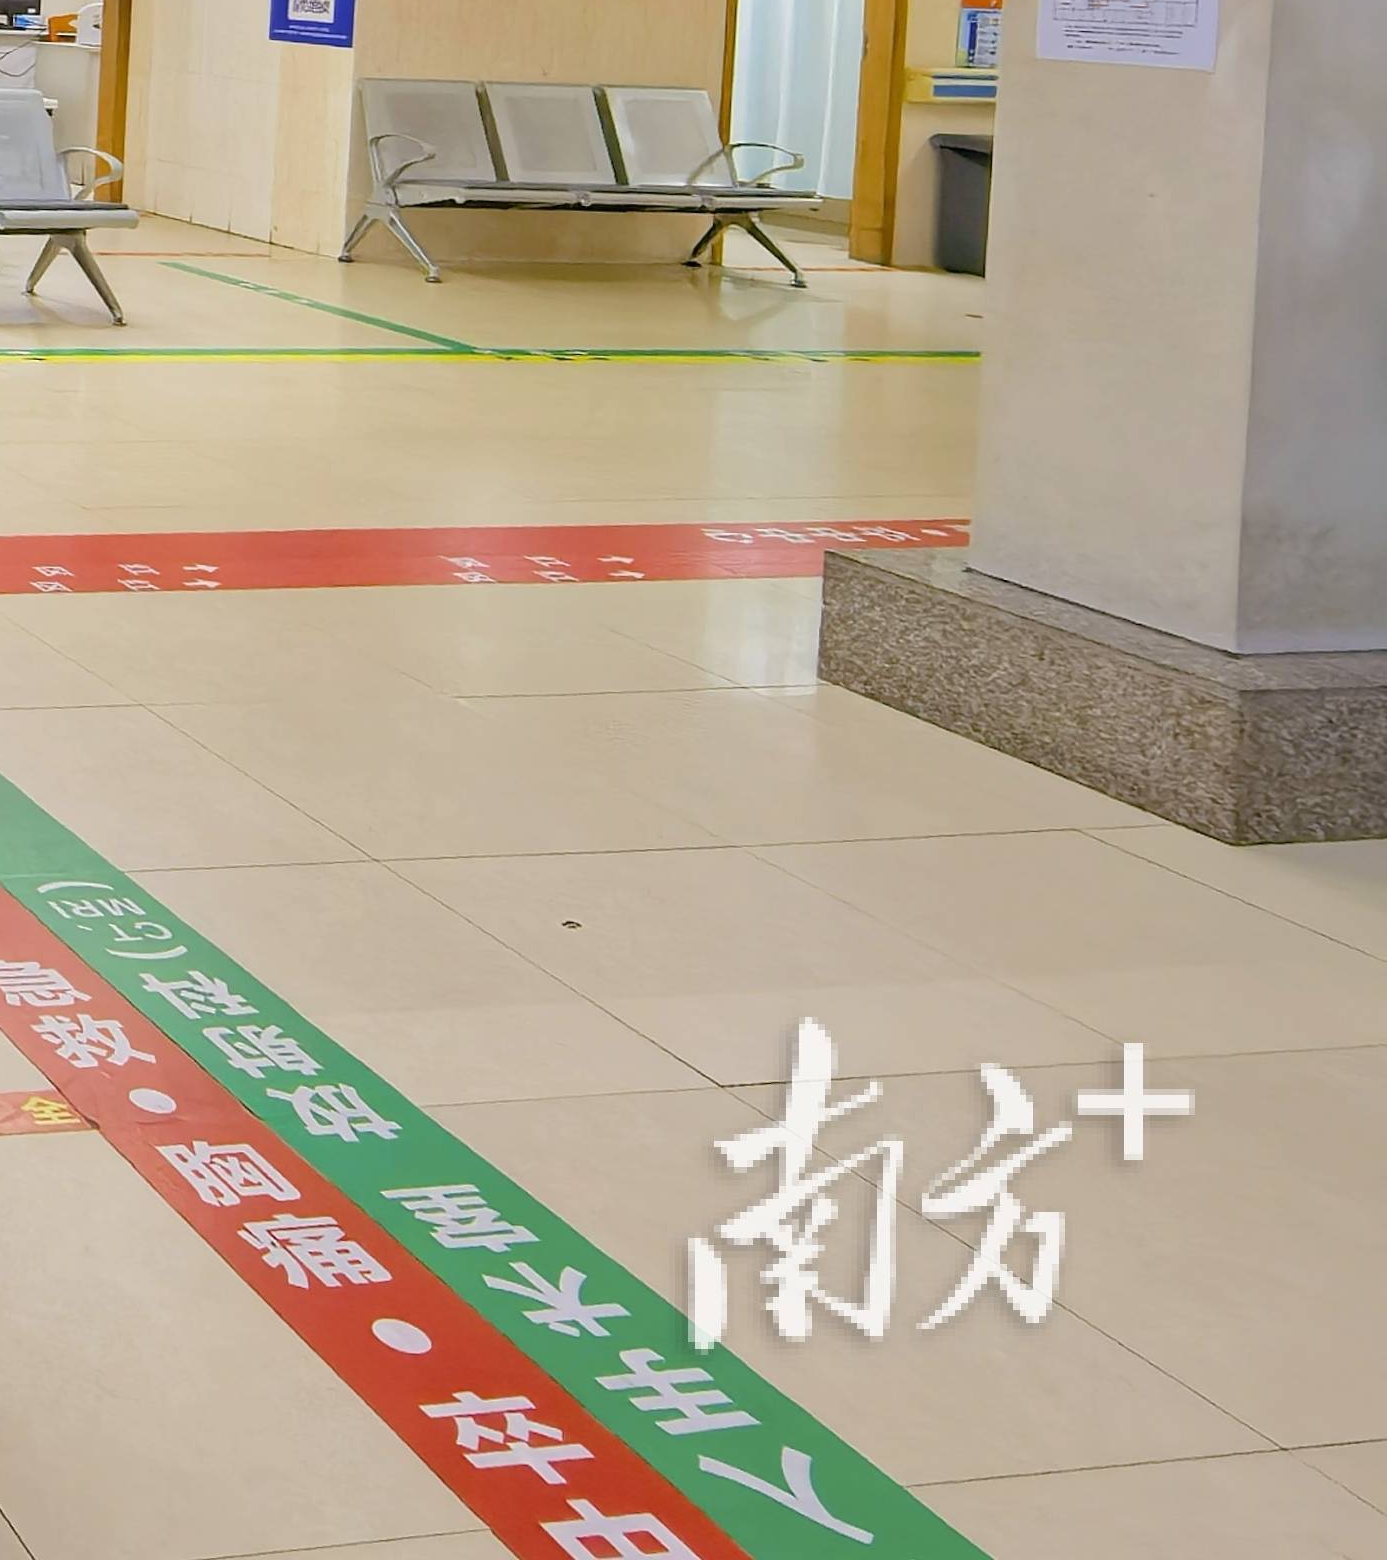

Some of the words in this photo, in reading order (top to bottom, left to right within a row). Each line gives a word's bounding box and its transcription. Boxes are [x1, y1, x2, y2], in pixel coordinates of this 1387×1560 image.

[139, 969, 404, 1144] 放射科
[159, 1139, 393, 1291] 胸痛
